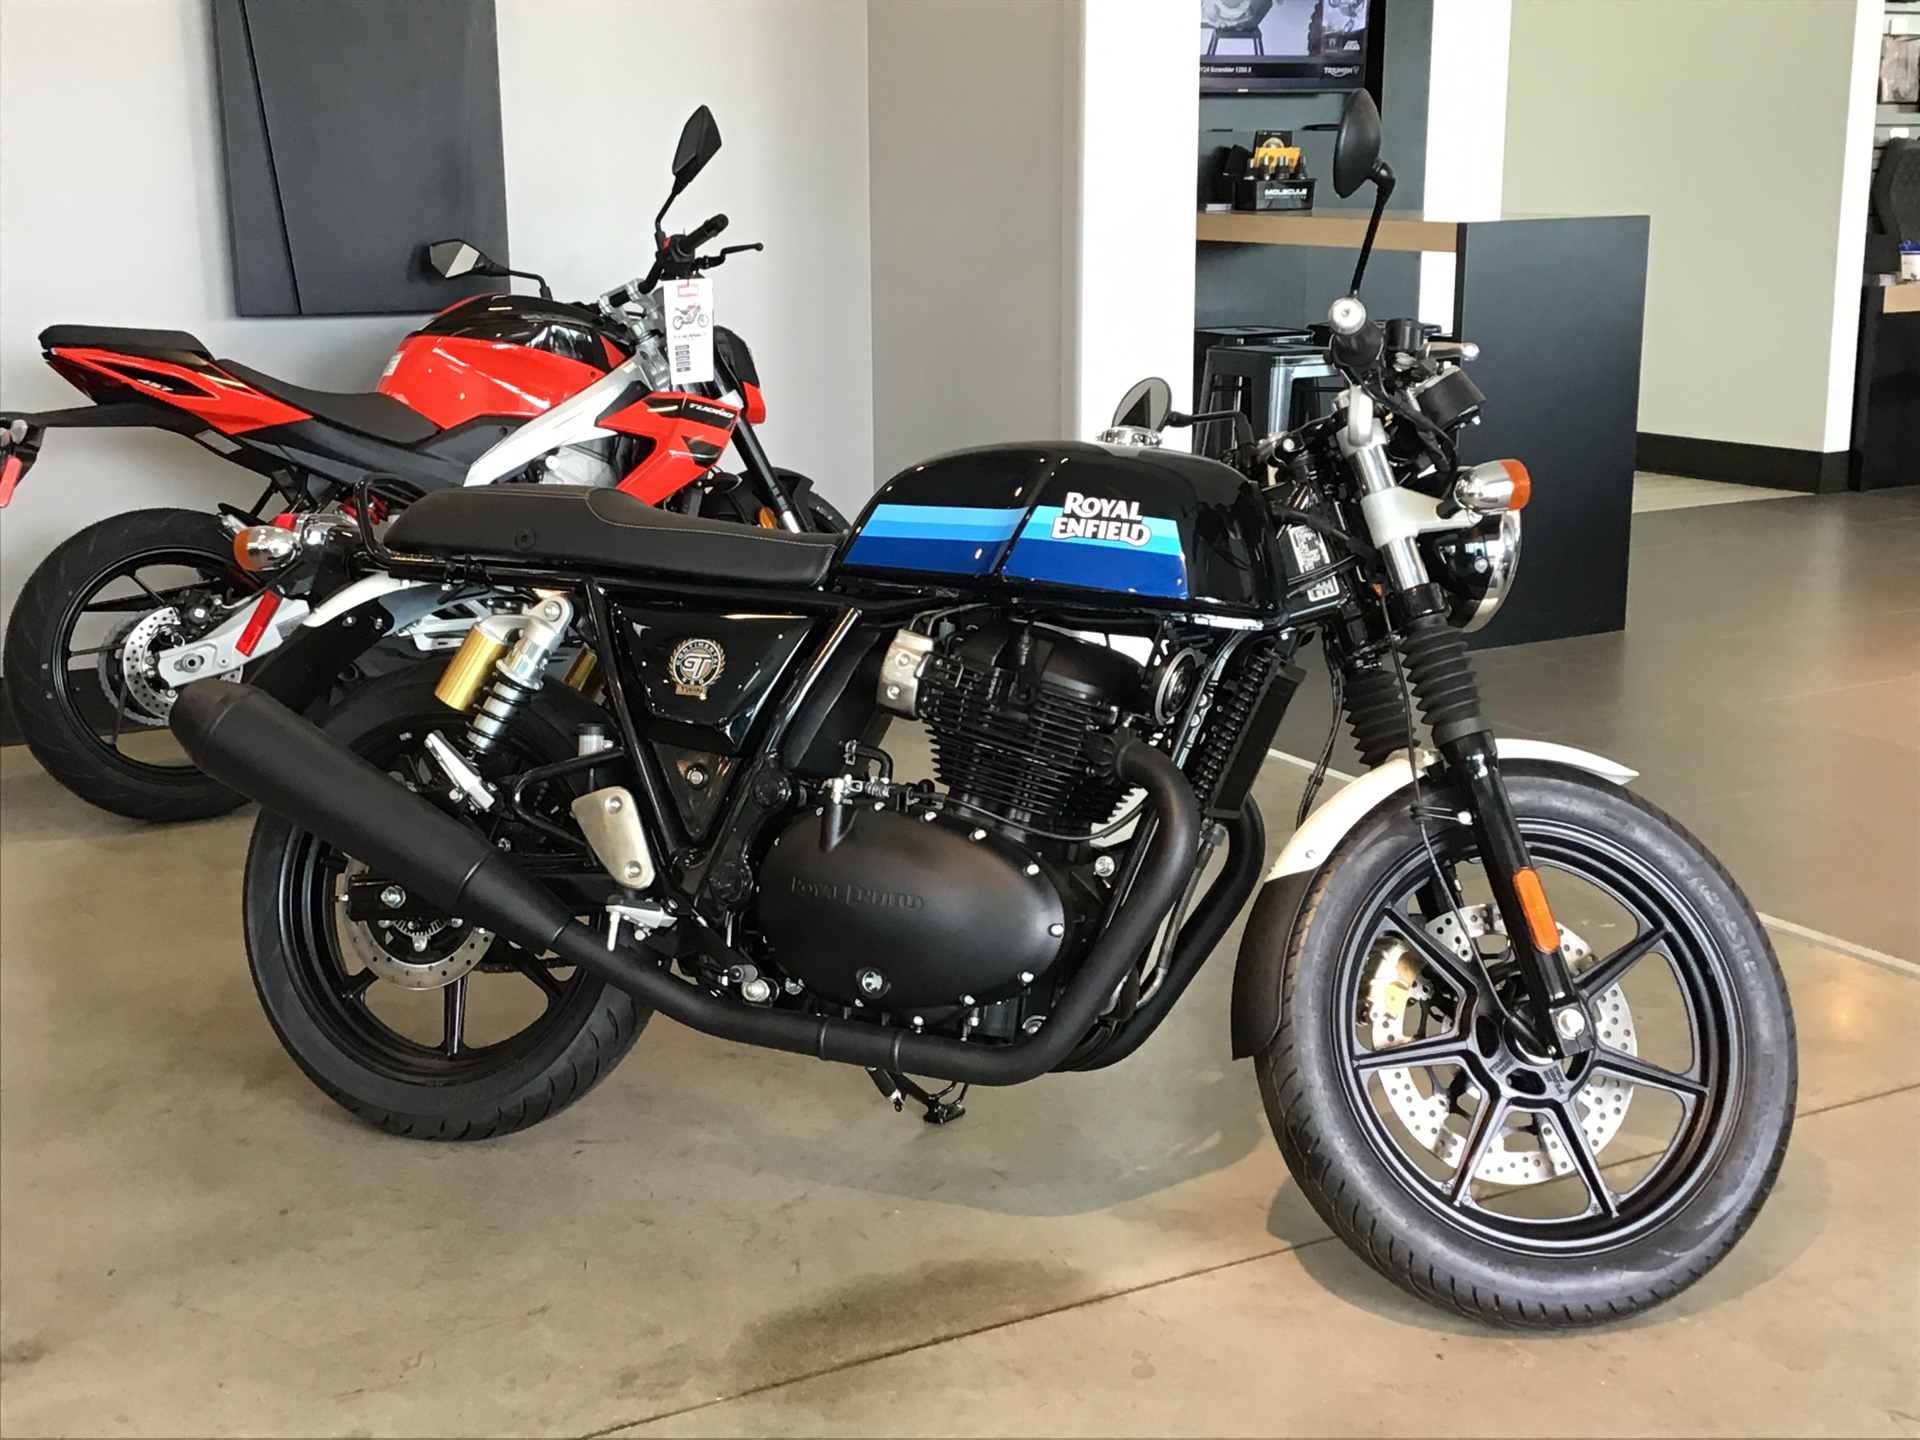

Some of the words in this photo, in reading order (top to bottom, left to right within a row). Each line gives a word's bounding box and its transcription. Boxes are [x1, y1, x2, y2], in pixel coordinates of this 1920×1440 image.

[1324, 66, 1352, 77] TRIUMPH
[689, 403, 735, 418] TUONO
[1063, 492, 1143, 520] ROYAL
[1051, 517, 1151, 547] ENFIELD
[682, 653, 713, 680] GT
[681, 686, 704, 694] TWIN
[791, 876, 839, 900] ROYAL
[845, 884, 925, 912] ENFIELD
